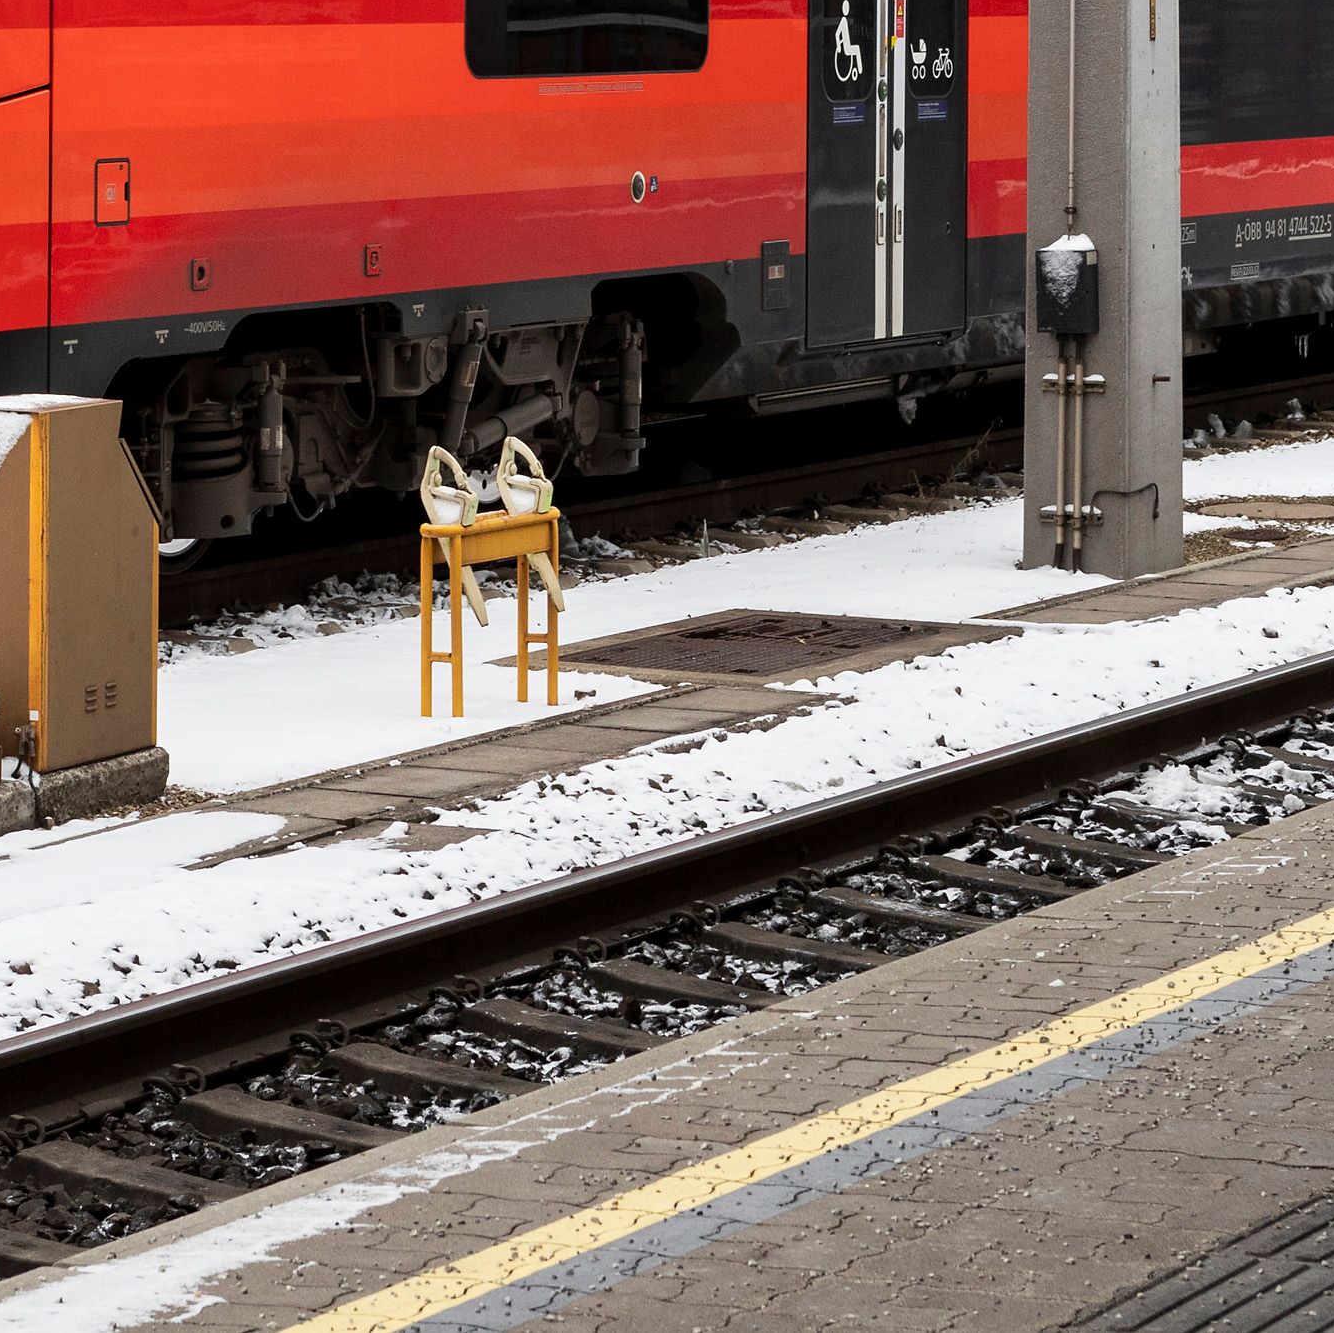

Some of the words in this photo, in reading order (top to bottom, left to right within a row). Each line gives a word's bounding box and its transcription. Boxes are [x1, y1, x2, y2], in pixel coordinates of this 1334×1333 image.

[1265, 220, 1276, 239] 94
[1277, 219, 1287, 237] 81
[1289, 216, 1308, 236] 4744
[1310, 214, 1332, 233] 522-5
